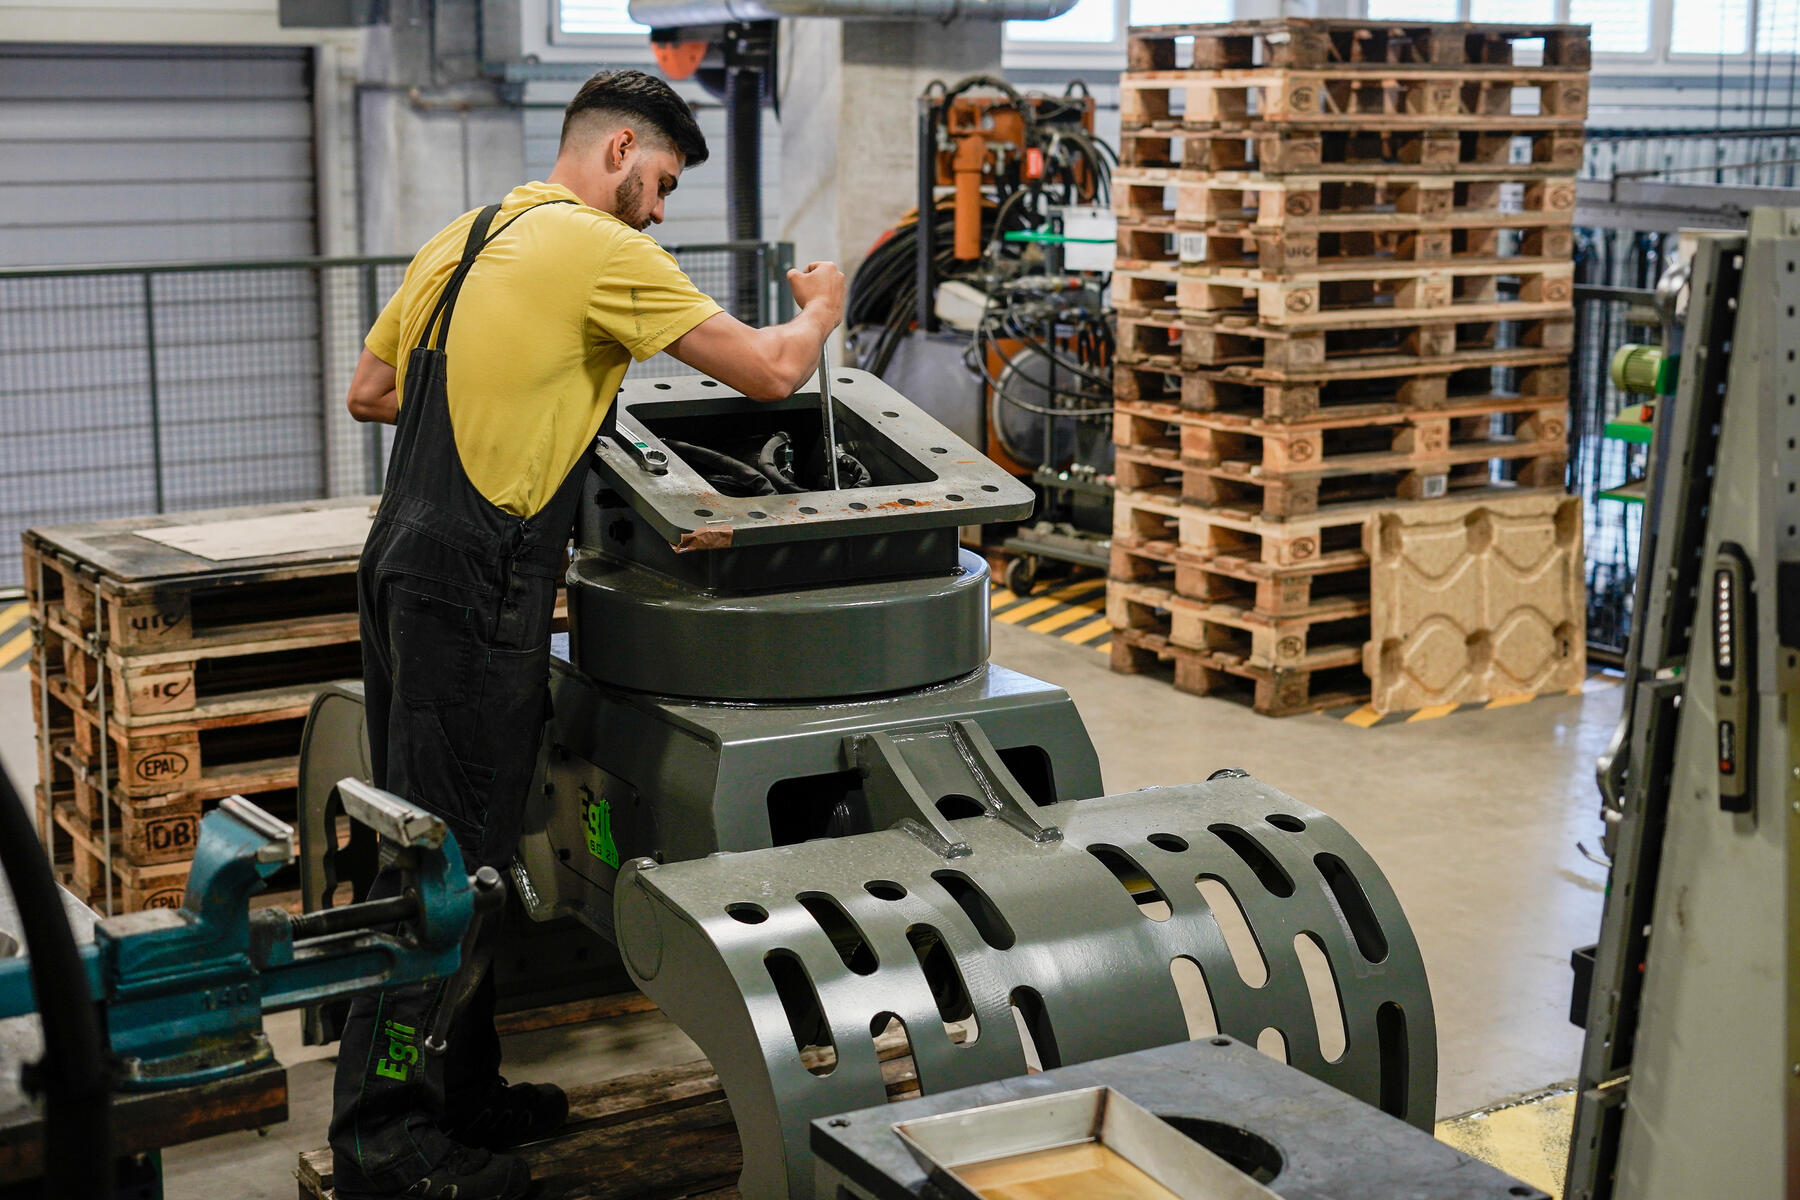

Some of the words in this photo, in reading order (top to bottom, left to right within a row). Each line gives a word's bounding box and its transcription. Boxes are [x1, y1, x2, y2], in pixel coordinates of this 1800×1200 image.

[144, 757, 179, 777] EPAL
[153, 821, 191, 850] DB
[376, 1019, 418, 1082] Egli
